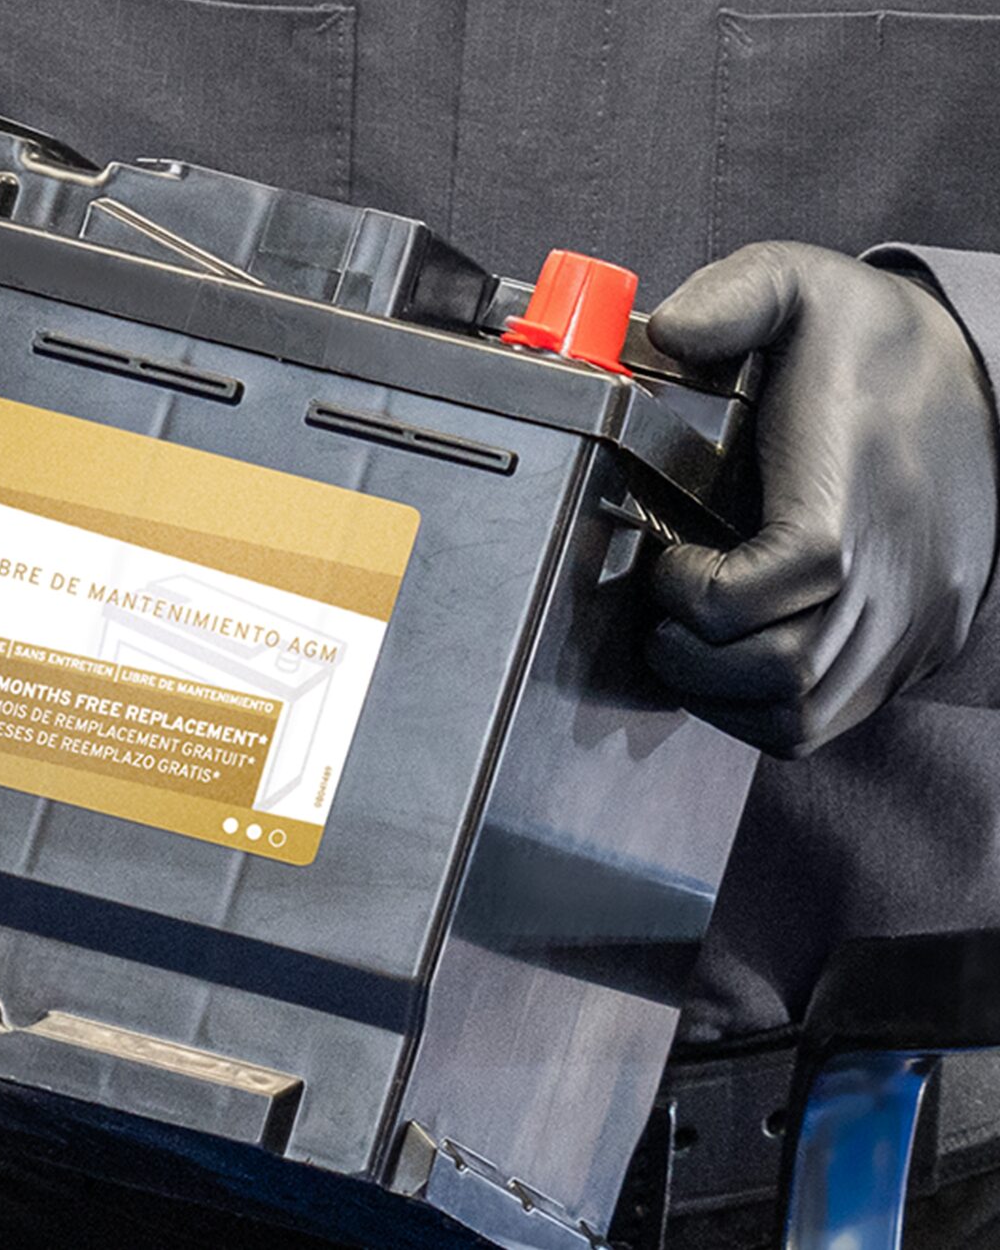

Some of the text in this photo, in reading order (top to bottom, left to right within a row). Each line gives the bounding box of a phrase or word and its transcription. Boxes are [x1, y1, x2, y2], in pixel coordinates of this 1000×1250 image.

[50, 572, 81, 595] DE
[87, 583, 280, 648] MANTENIMIENTO
[287, 637, 338, 663] AGM
[15, 645, 113, 677] SANS ENTRETIEN
[73, 694, 123, 718] FREE
[121, 670, 274, 714] LIBRE DE MANTENIMIENTO
[30, 707, 52, 725] DE
[54, 712, 180, 753] REMPLACEMENT
[36, 730, 57, 748] DE
[60, 736, 155, 770] REEMPLAZO
